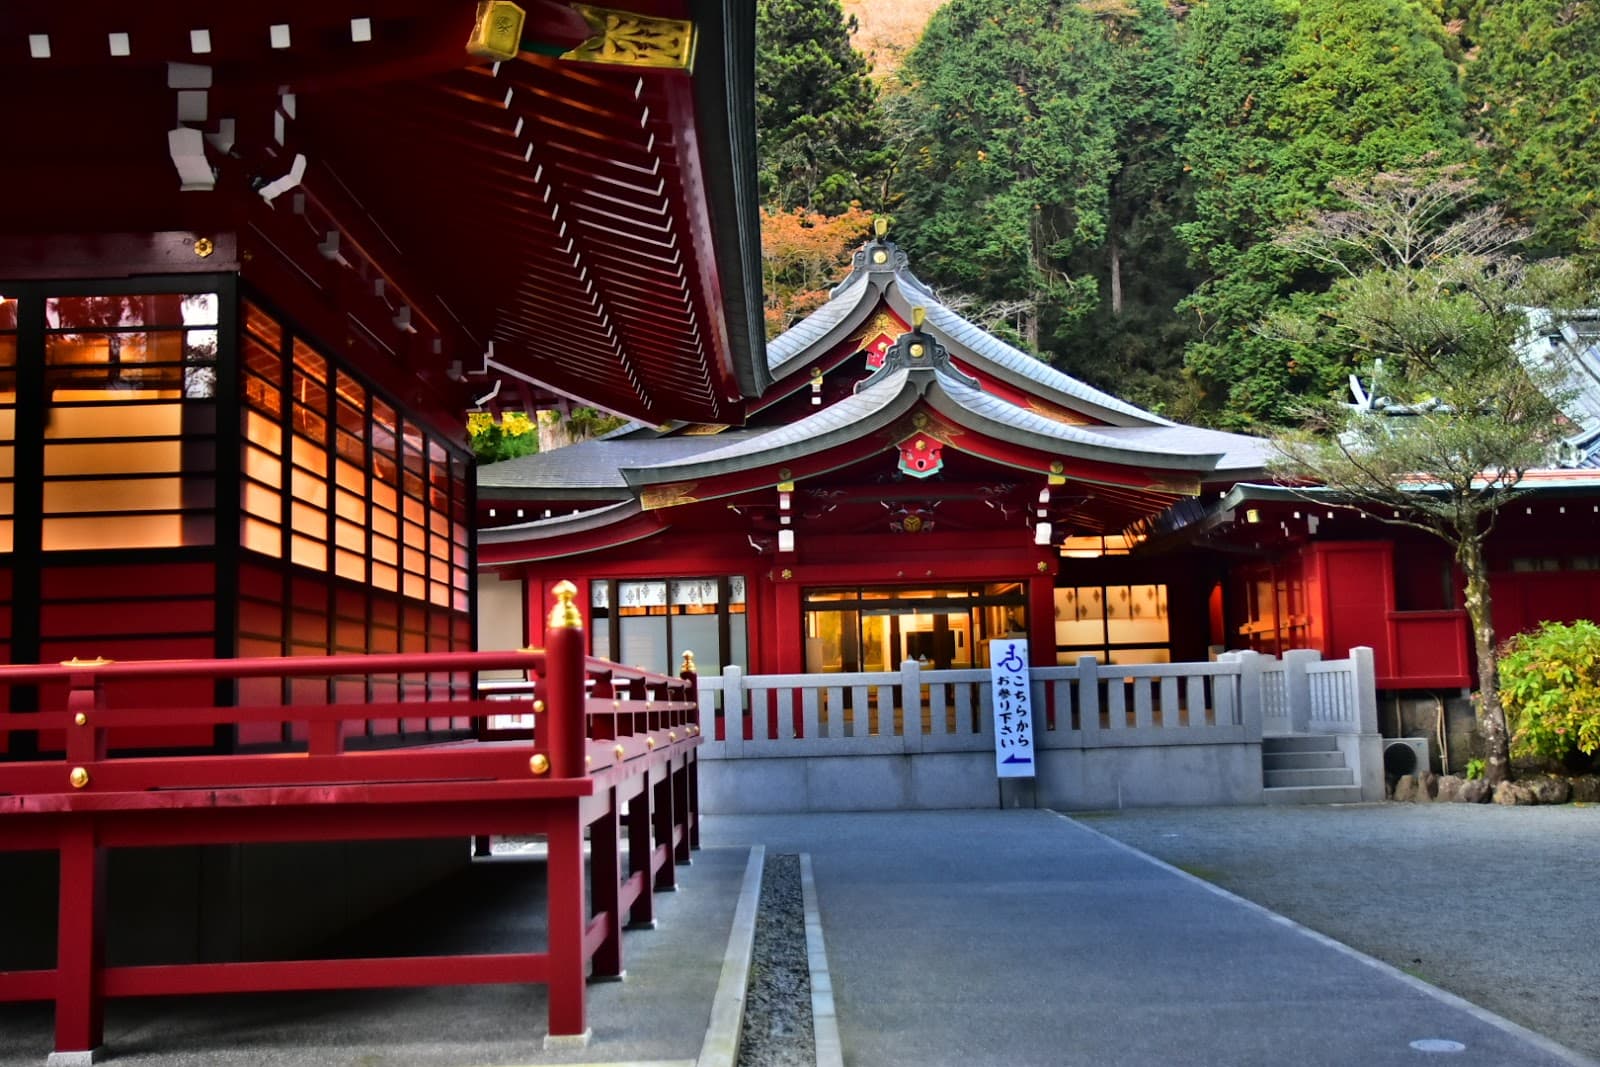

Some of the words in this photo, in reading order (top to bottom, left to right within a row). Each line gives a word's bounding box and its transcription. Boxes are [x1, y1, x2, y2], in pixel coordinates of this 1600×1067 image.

[997, 676, 1014, 748] お参り下さい
[1013, 676, 1029, 747] こちらから
